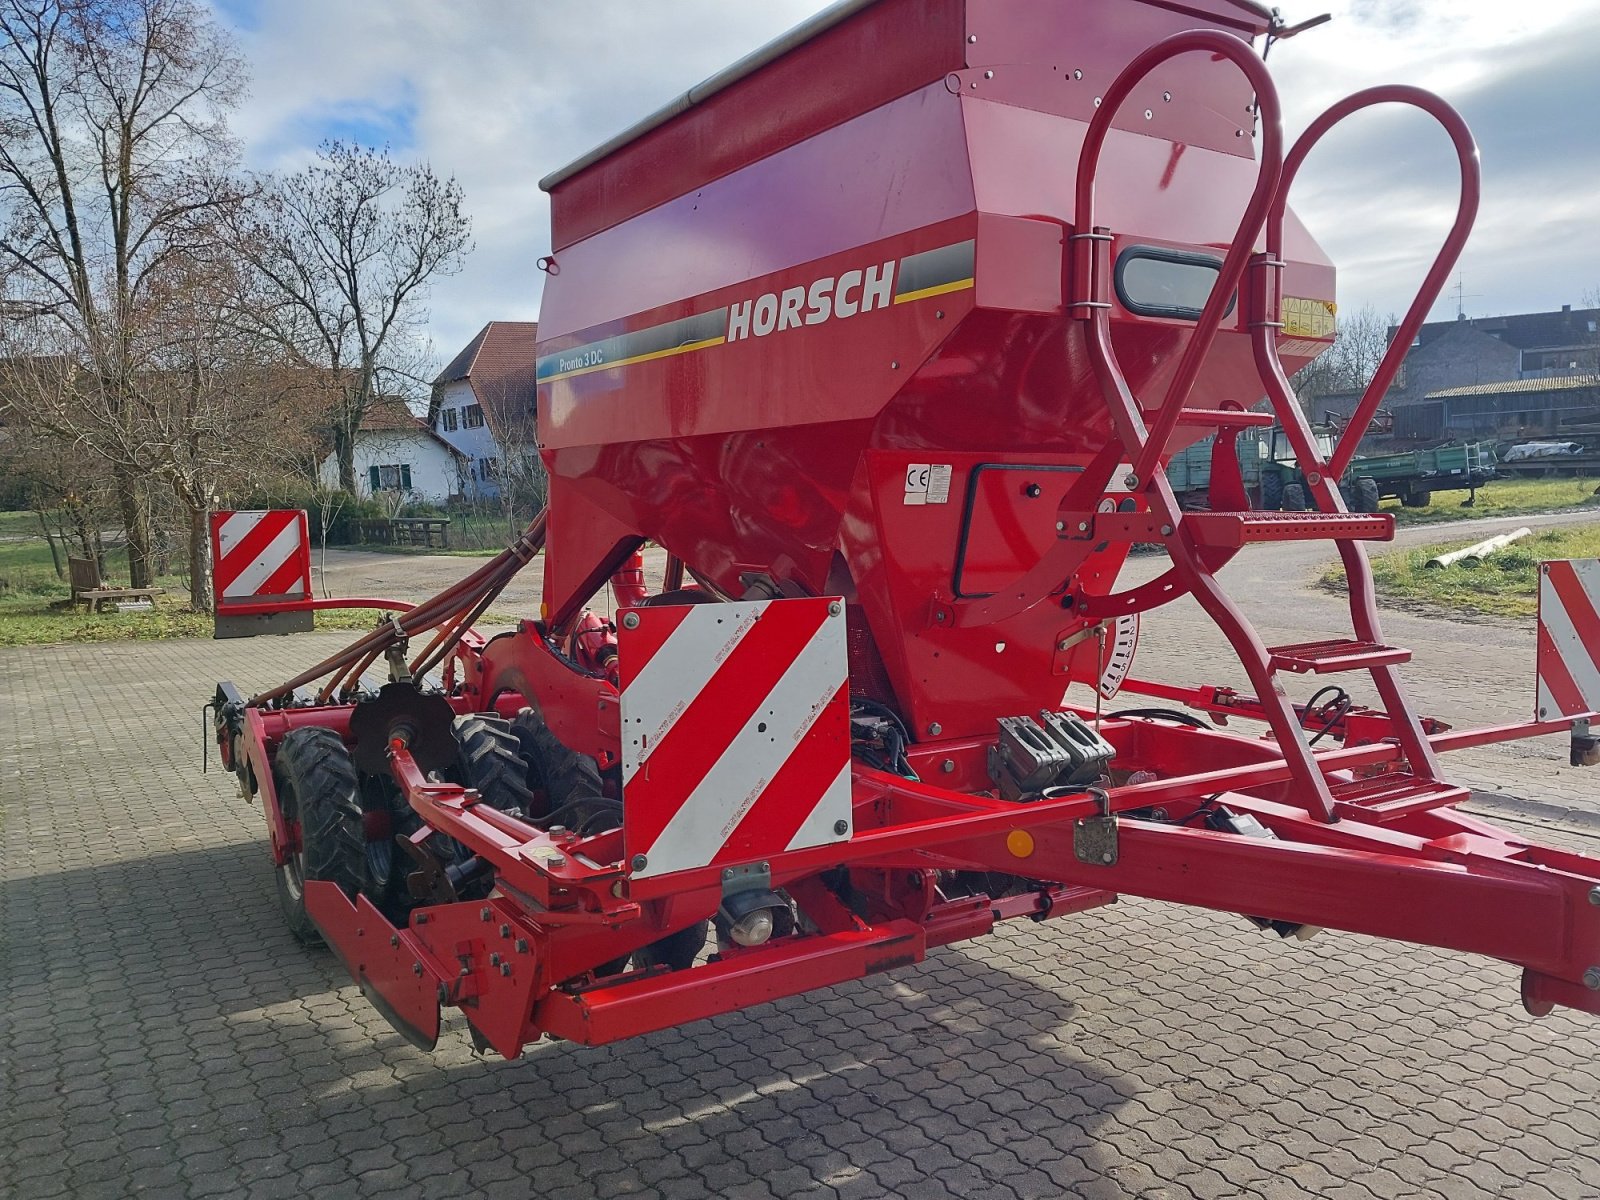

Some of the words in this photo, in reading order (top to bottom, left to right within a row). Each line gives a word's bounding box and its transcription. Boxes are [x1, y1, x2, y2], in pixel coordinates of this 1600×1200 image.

[727, 260, 896, 343] HORSCH
[560, 356, 583, 372] Pronto
[584, 352, 589, 366] 3
[590, 349, 603, 365] DC
[1129, 626, 1135, 635] 2
[1127, 639, 1133, 648] 3
[1125, 651, 1131, 659] 4
[1120, 663, 1127, 671] 5
[1115, 675, 1122, 683] 6
[1108, 686, 1115, 694] 7
